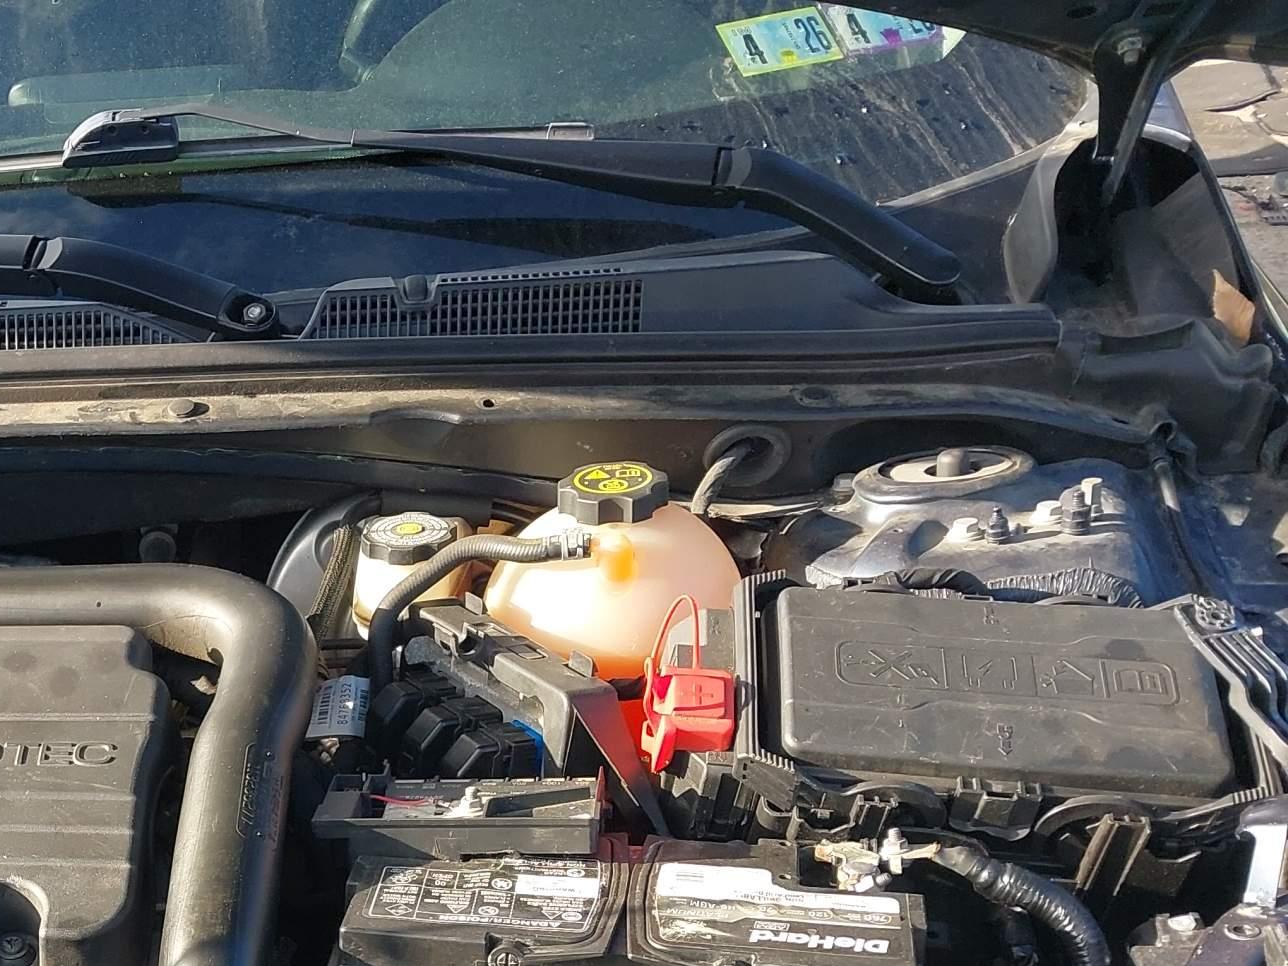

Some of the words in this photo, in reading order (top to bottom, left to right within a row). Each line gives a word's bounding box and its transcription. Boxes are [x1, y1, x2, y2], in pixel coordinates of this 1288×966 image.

[743, 34, 769, 64] 4
[794, 15, 832, 54] 26
[847, 14, 872, 44] 4
[808, 910, 830, 918] 120
[749, 929, 890, 954] DieHard
